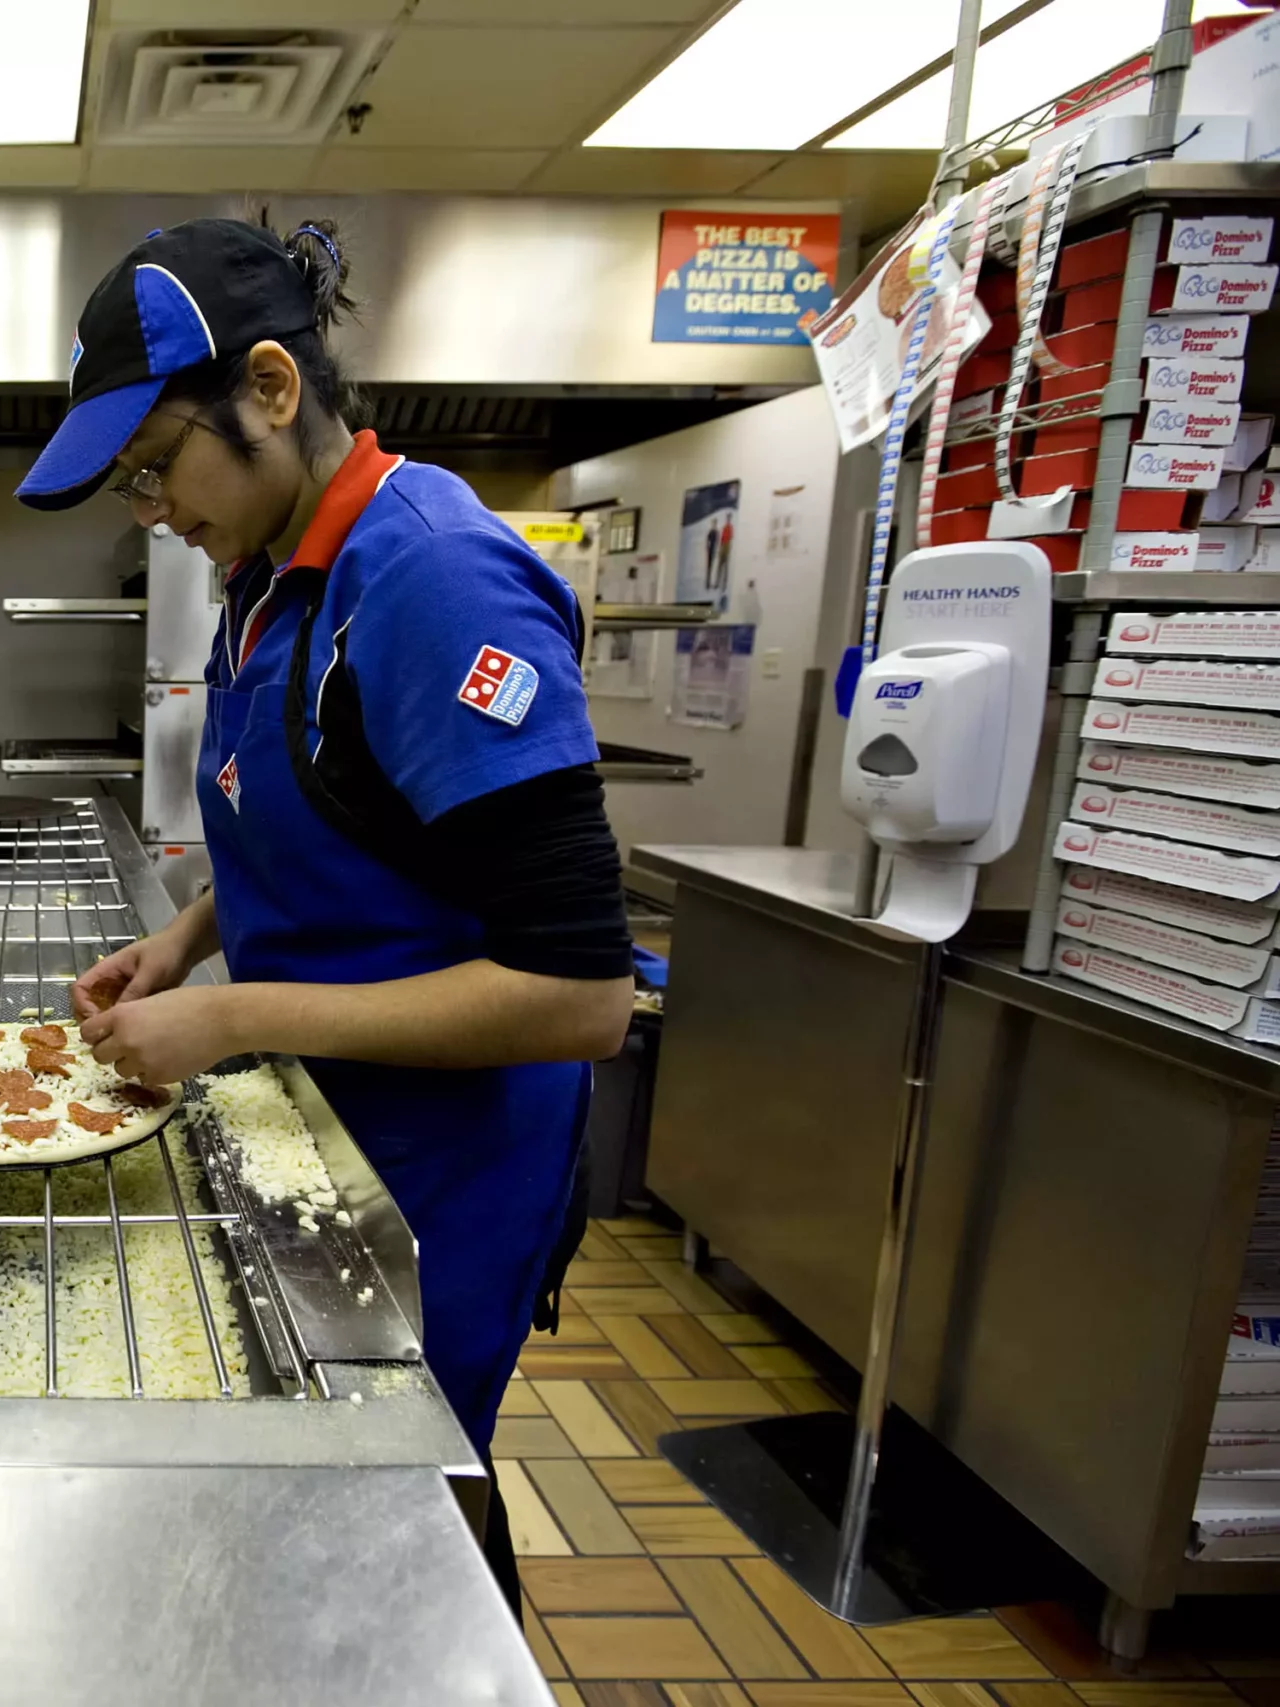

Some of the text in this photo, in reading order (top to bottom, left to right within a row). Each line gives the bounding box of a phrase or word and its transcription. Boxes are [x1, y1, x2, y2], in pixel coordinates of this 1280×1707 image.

[694, 225, 807, 247] THE BEST
[1214, 230, 1263, 243] Domino's
[1211, 243, 1241, 257] Pizza
[695, 249, 800, 270] PIZZA IS
[663, 269, 828, 292] A MATTER OF
[1220, 278, 1268, 291] Domino's
[685, 293, 800, 314] DEGREES.
[1216, 291, 1245, 305] Pizza
[1183, 326, 1238, 339] Domino's
[1180, 340, 1214, 352] Pizza
[1190, 370, 1237, 384] Domino's
[1187, 383, 1216, 395] Pizza
[1187, 413, 1231, 426] Domino's
[1184, 426, 1211, 438] Pizza
[1170, 458, 1216, 472] Domino's
[1168, 471, 1195, 483] Pizza
[1132, 543, 1189, 556] Domino's
[1130, 556, 1164, 568] Pizza
[903, 586, 1021, 601] HEALTHY HANDS
[906, 602, 1014, 619] START HERE
[492, 666, 526, 715] Domino's
[879, 684, 919, 697] Purell
[506, 690, 531, 721] Pizza
